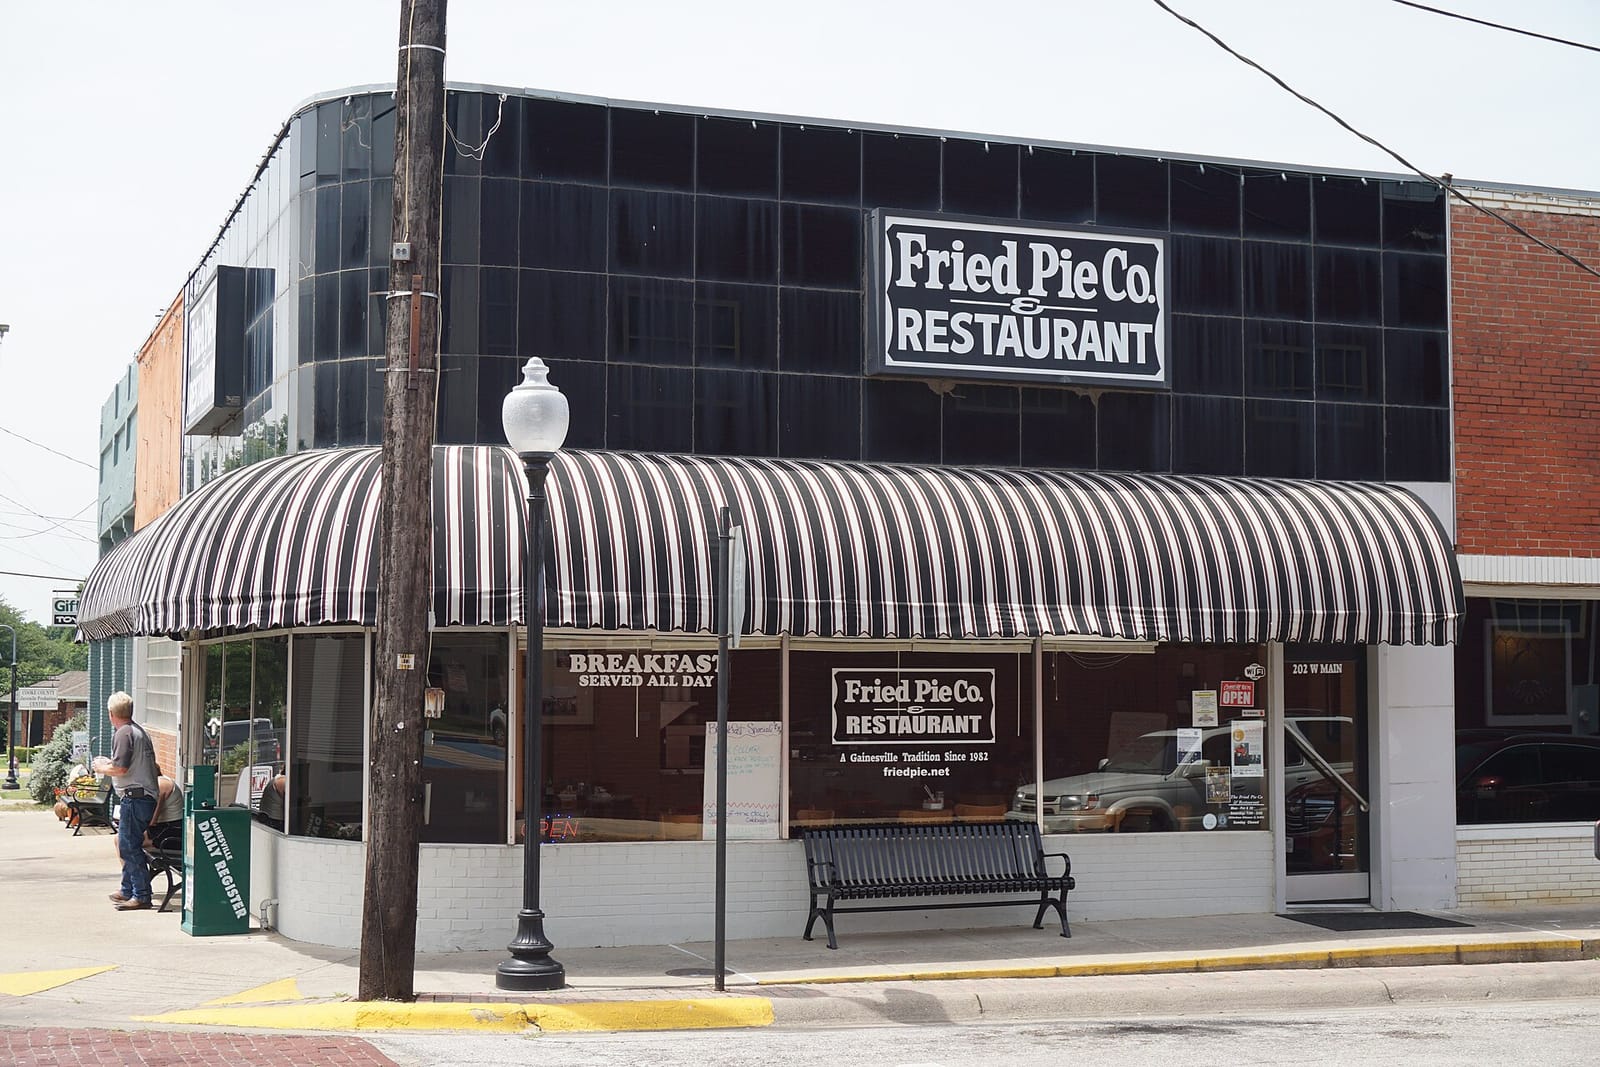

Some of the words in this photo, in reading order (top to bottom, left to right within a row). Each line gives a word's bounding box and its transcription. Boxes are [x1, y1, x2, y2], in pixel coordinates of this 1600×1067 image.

[896, 232, 1021, 295] Fried
[1028, 242, 1098, 300] Pie
[1102, 248, 1156, 304] Co.
[897, 307, 1153, 365] RESTAURANT
[1292, 664, 1308, 674] 202
[1310, 664, 1319, 674] W
[1320, 664, 1343, 674] MAIN
[579, 675, 643, 687] SERVED
[647, 675, 678, 687] ALL
[682, 675, 714, 687] DAY
[844, 678, 911, 703] Fried
[914, 679, 952, 703] Pie
[953, 679, 984, 703] Co.
[1223, 691, 1250, 704] OPEN
[846, 715, 982, 734] RESTAURANT
[840, 753, 846, 763] A
[850, 752, 898, 763] Gainesville
[902, 751, 941, 762] Tradition
[944, 751, 966, 761] Since
[969, 752, 989, 761] 1982
[883, 767, 950, 778] friedpie.net
[521, 821, 579, 838] PEN
[210, 817, 234, 861] GAINESVILLE
[198, 820, 222, 857] DAILY
[215, 860, 247, 919] REGISTER
